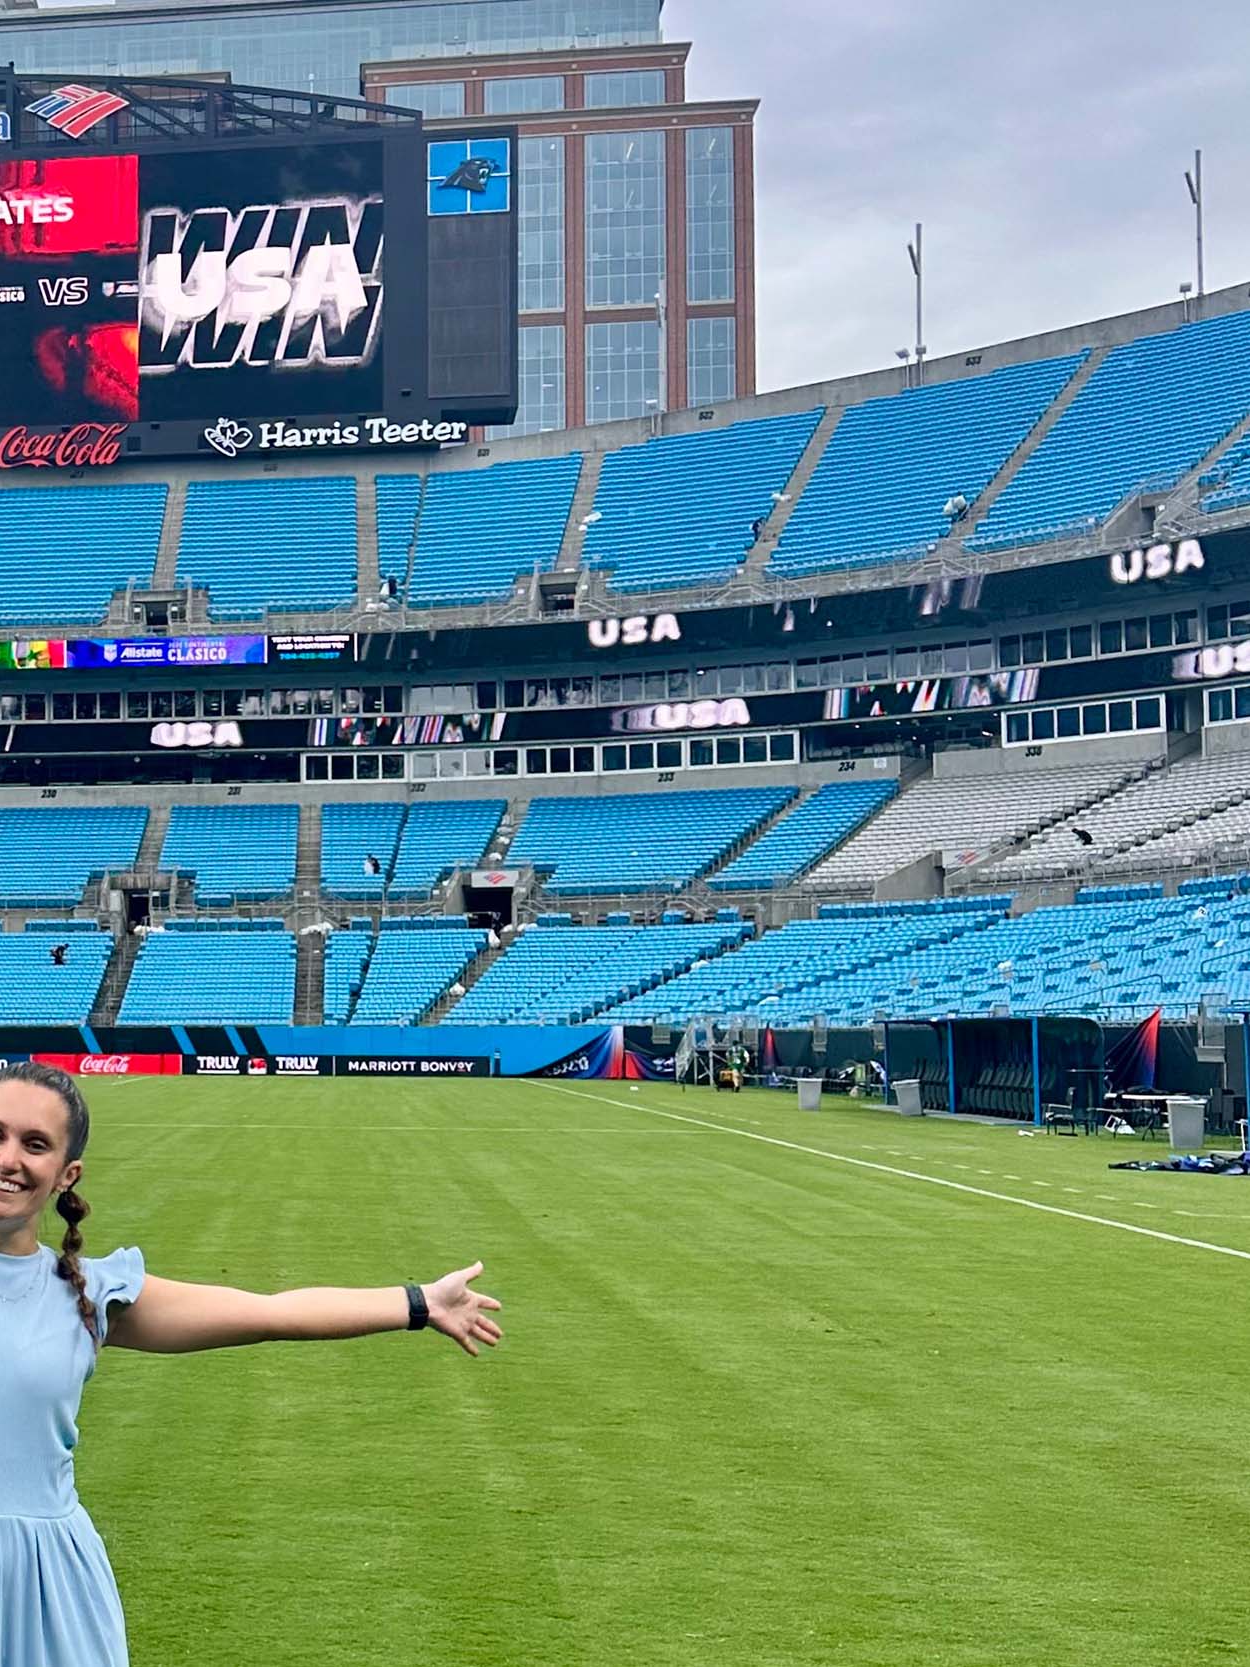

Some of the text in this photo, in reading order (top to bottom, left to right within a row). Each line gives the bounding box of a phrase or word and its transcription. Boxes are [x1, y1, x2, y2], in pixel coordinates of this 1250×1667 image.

[38, 277, 88, 306] VS
[154, 246, 369, 319] USA
[259, 416, 467, 449] Harris Teeter
[1111, 539, 1205, 584] USA
[587, 612, 681, 648] USA
[121, 646, 163, 658] Allstate
[652, 697, 751, 731] USA
[150, 721, 243, 748] USA
[838, 761, 856, 772] 234
[197, 1056, 319, 1070] TRULY TRULY
[349, 1060, 416, 1072] MARRIOTT
